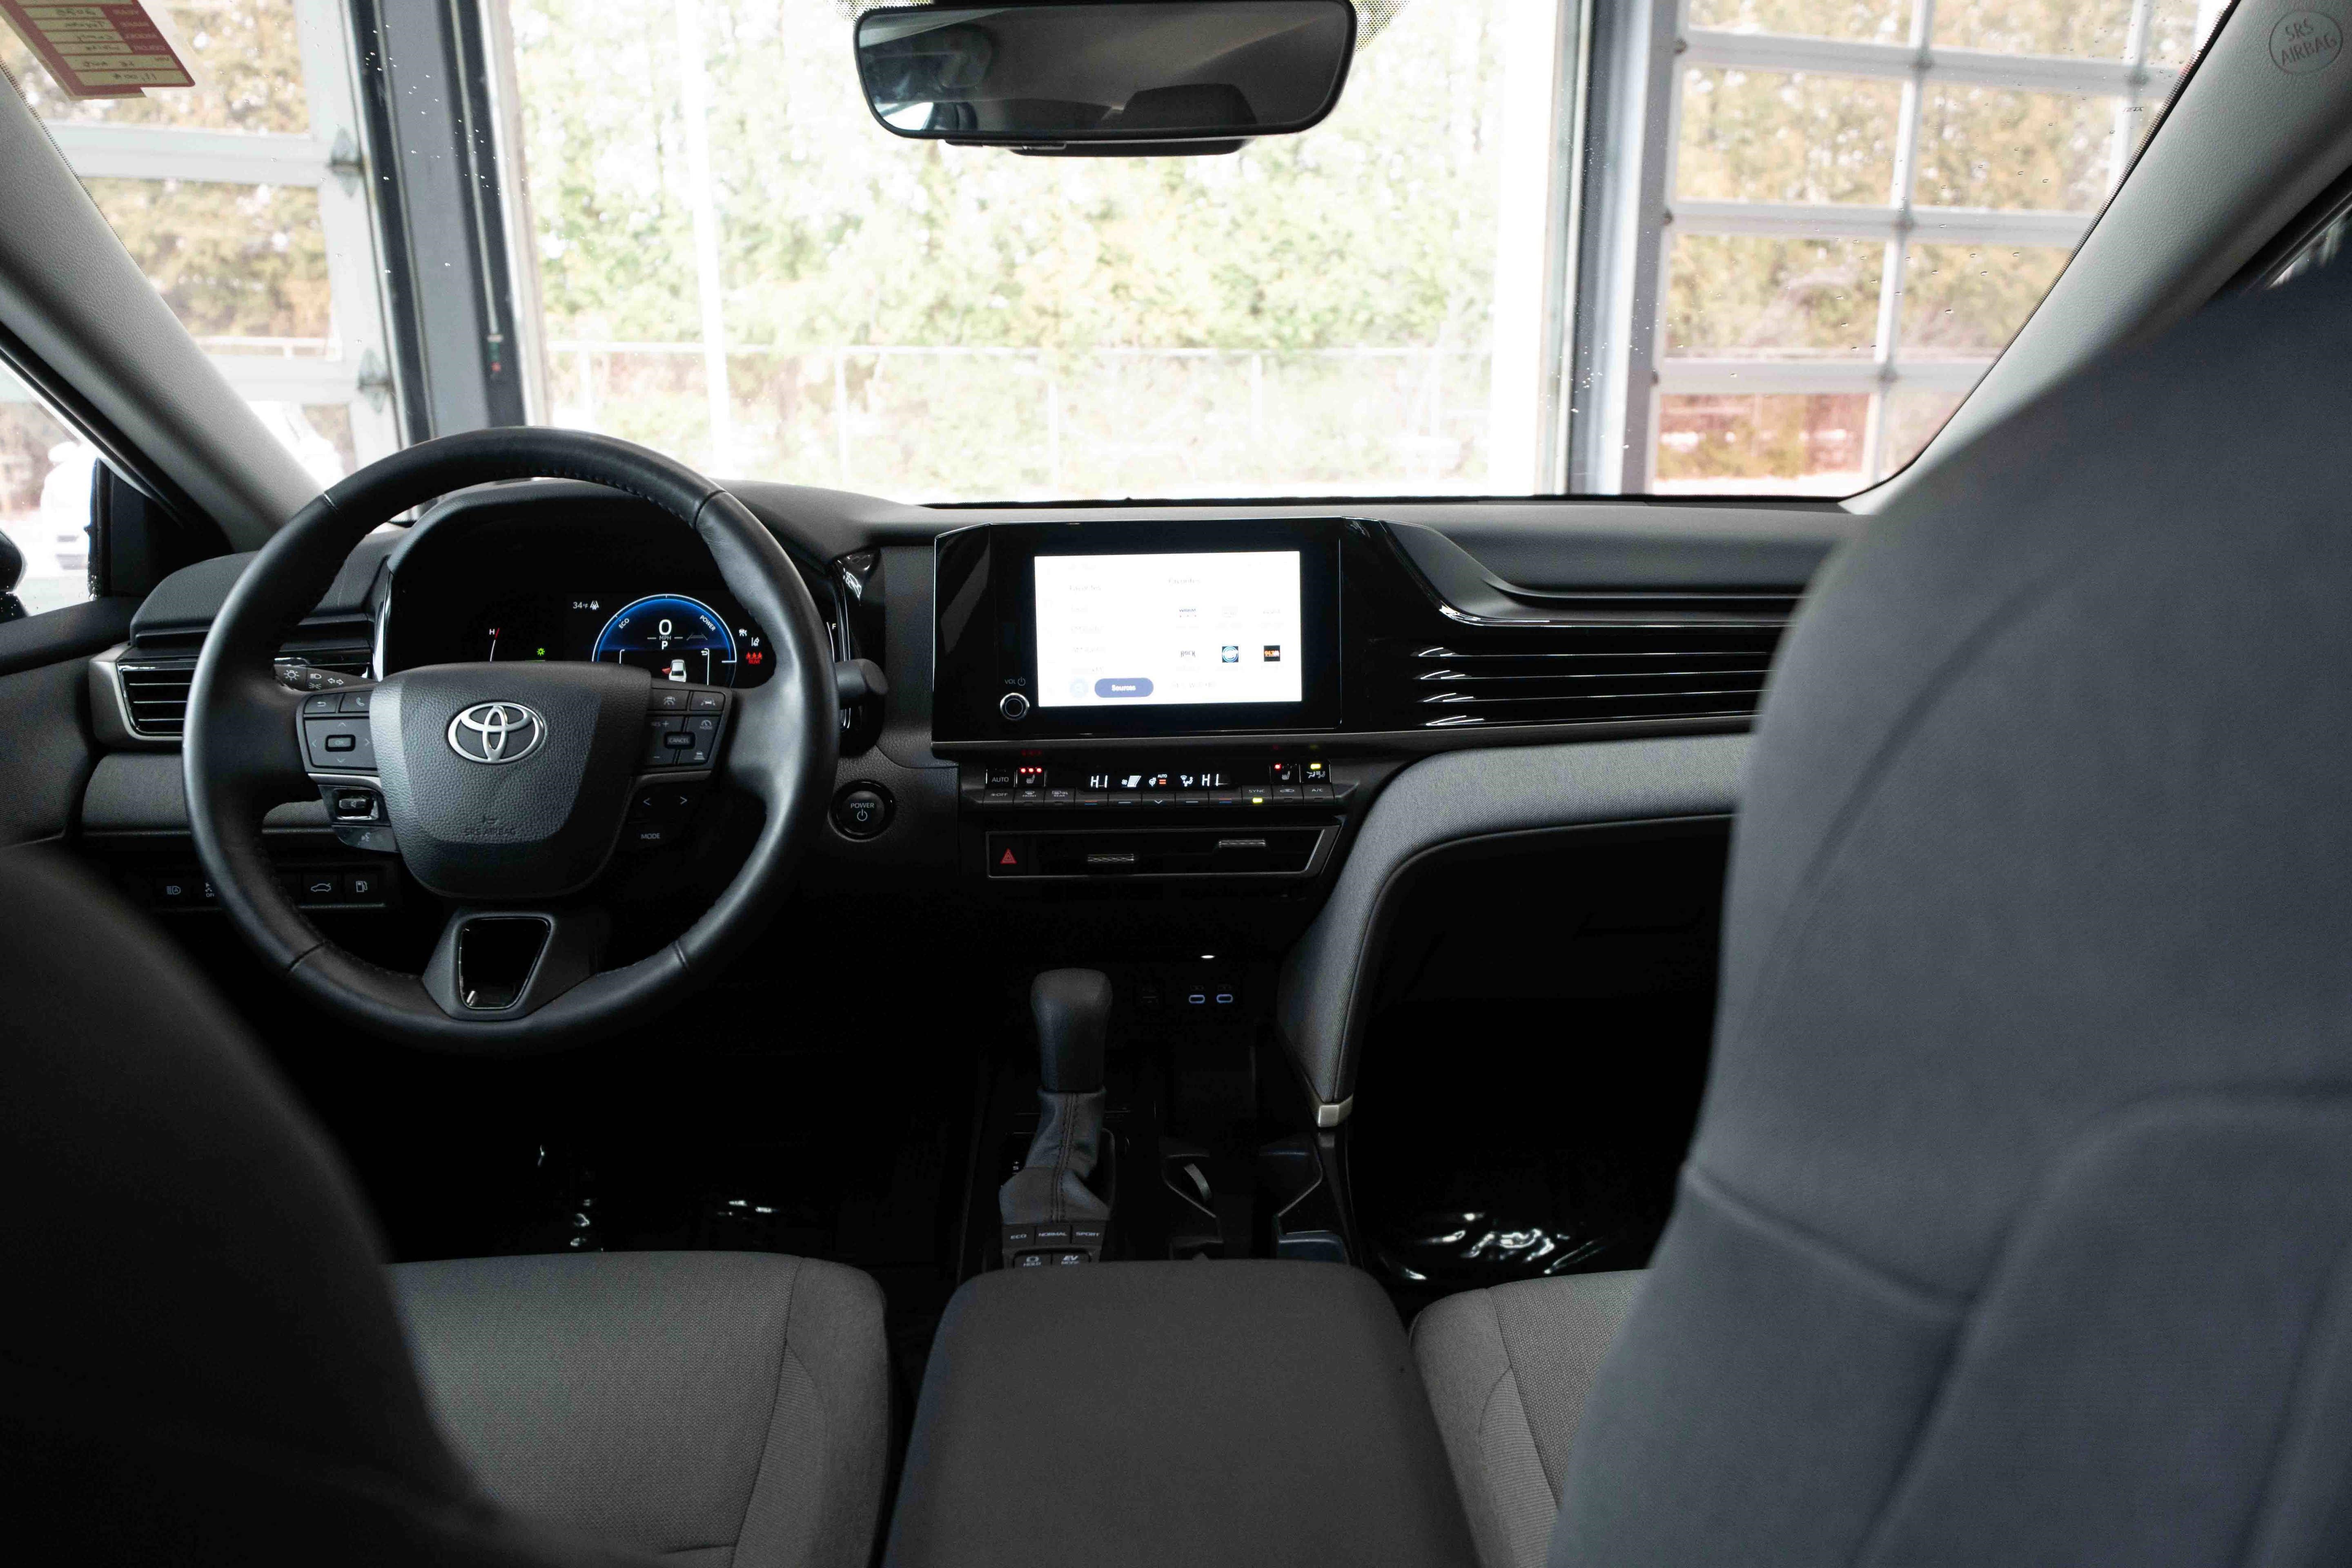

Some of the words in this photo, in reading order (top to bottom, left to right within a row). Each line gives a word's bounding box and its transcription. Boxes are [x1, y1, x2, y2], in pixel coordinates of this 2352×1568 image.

[2285, 18, 2314, 41] SRS
[2281, 33, 2337, 65] AIRBAG
[619, 618, 630, 629] ECO
[659, 619, 672, 635] 0
[699, 615, 716, 631] POWER
[662, 641, 668, 650] P
